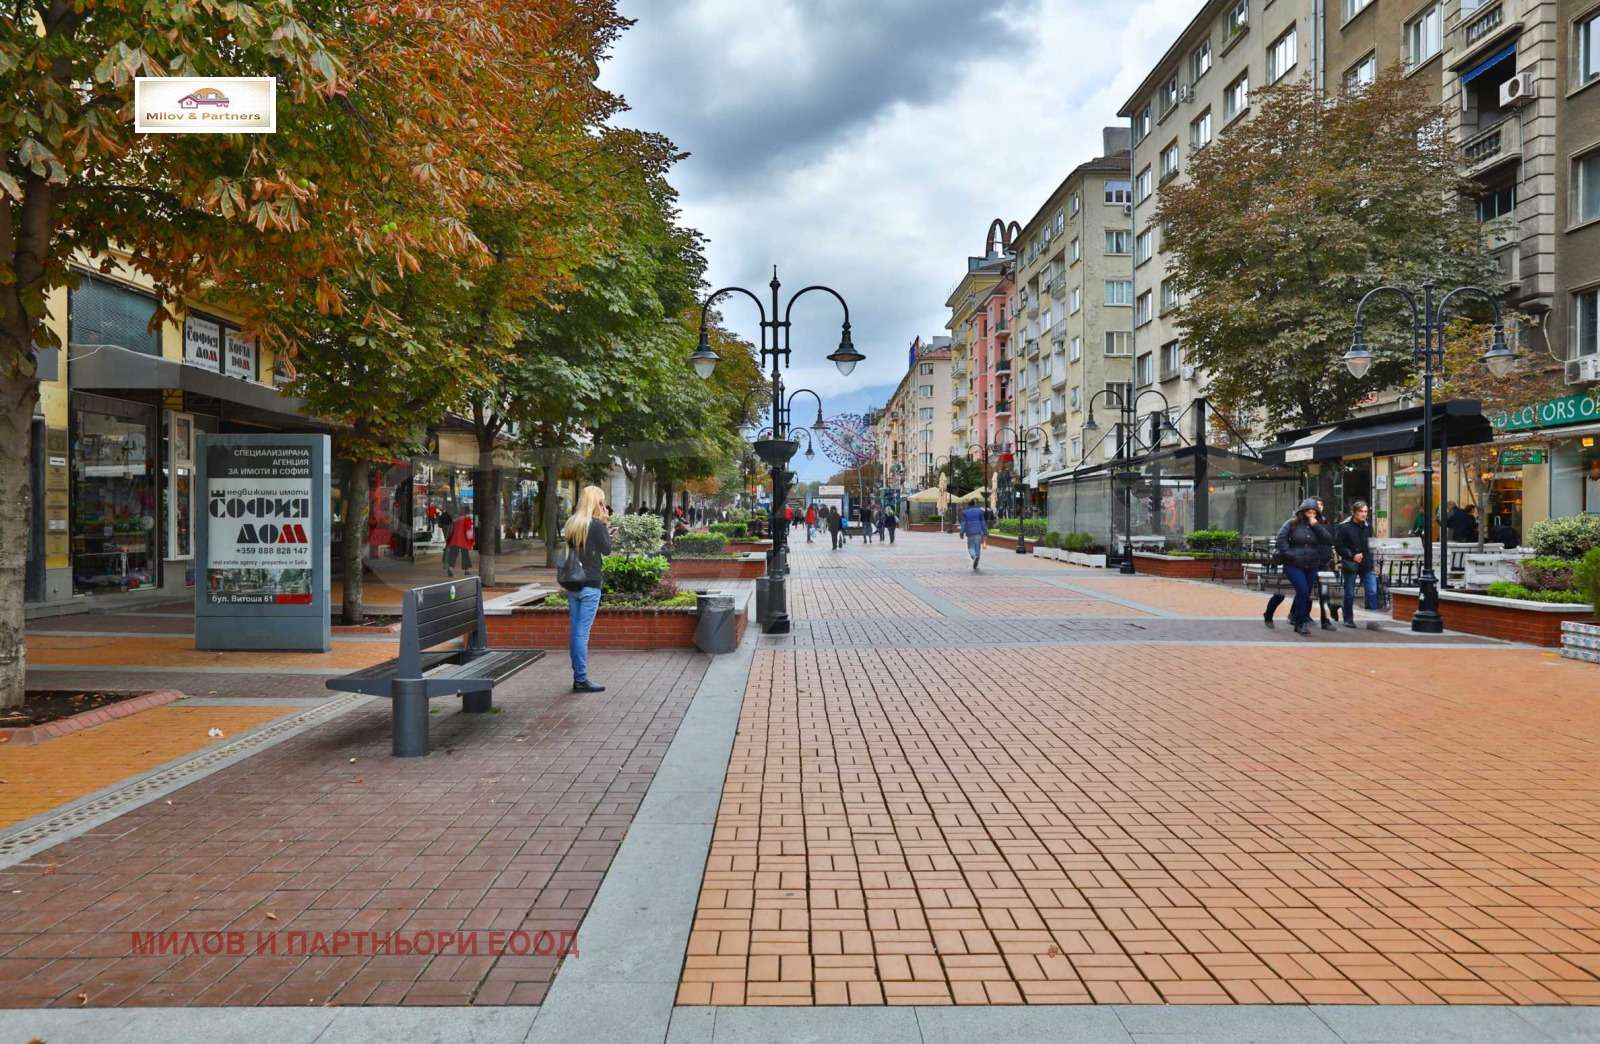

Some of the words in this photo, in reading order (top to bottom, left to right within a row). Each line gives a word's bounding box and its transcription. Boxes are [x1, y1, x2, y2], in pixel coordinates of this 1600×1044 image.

[187, 329, 218, 348] СОФИЯ
[196, 345, 217, 362] ДОМ
[228, 341, 250, 358] SOFIA
[231, 356, 250, 371] DOM
[1512, 399, 1575, 425] COLORS
[233, 449, 309, 457] СПЕЦИАЛИЗИРАНА
[279, 467, 309, 475] СОФИЯ
[227, 488, 277, 497] недвижими
[209, 497, 309, 518] СОФИЯ
[236, 524, 308, 544] ДОМ
[236, 547, 256, 555] +359
[258, 547, 274, 555] 888
[276, 547, 291, 555] 828
[294, 547, 308, 555] 147
[212, 595, 229, 603] бул.
[231, 595, 263, 603] Витоша
